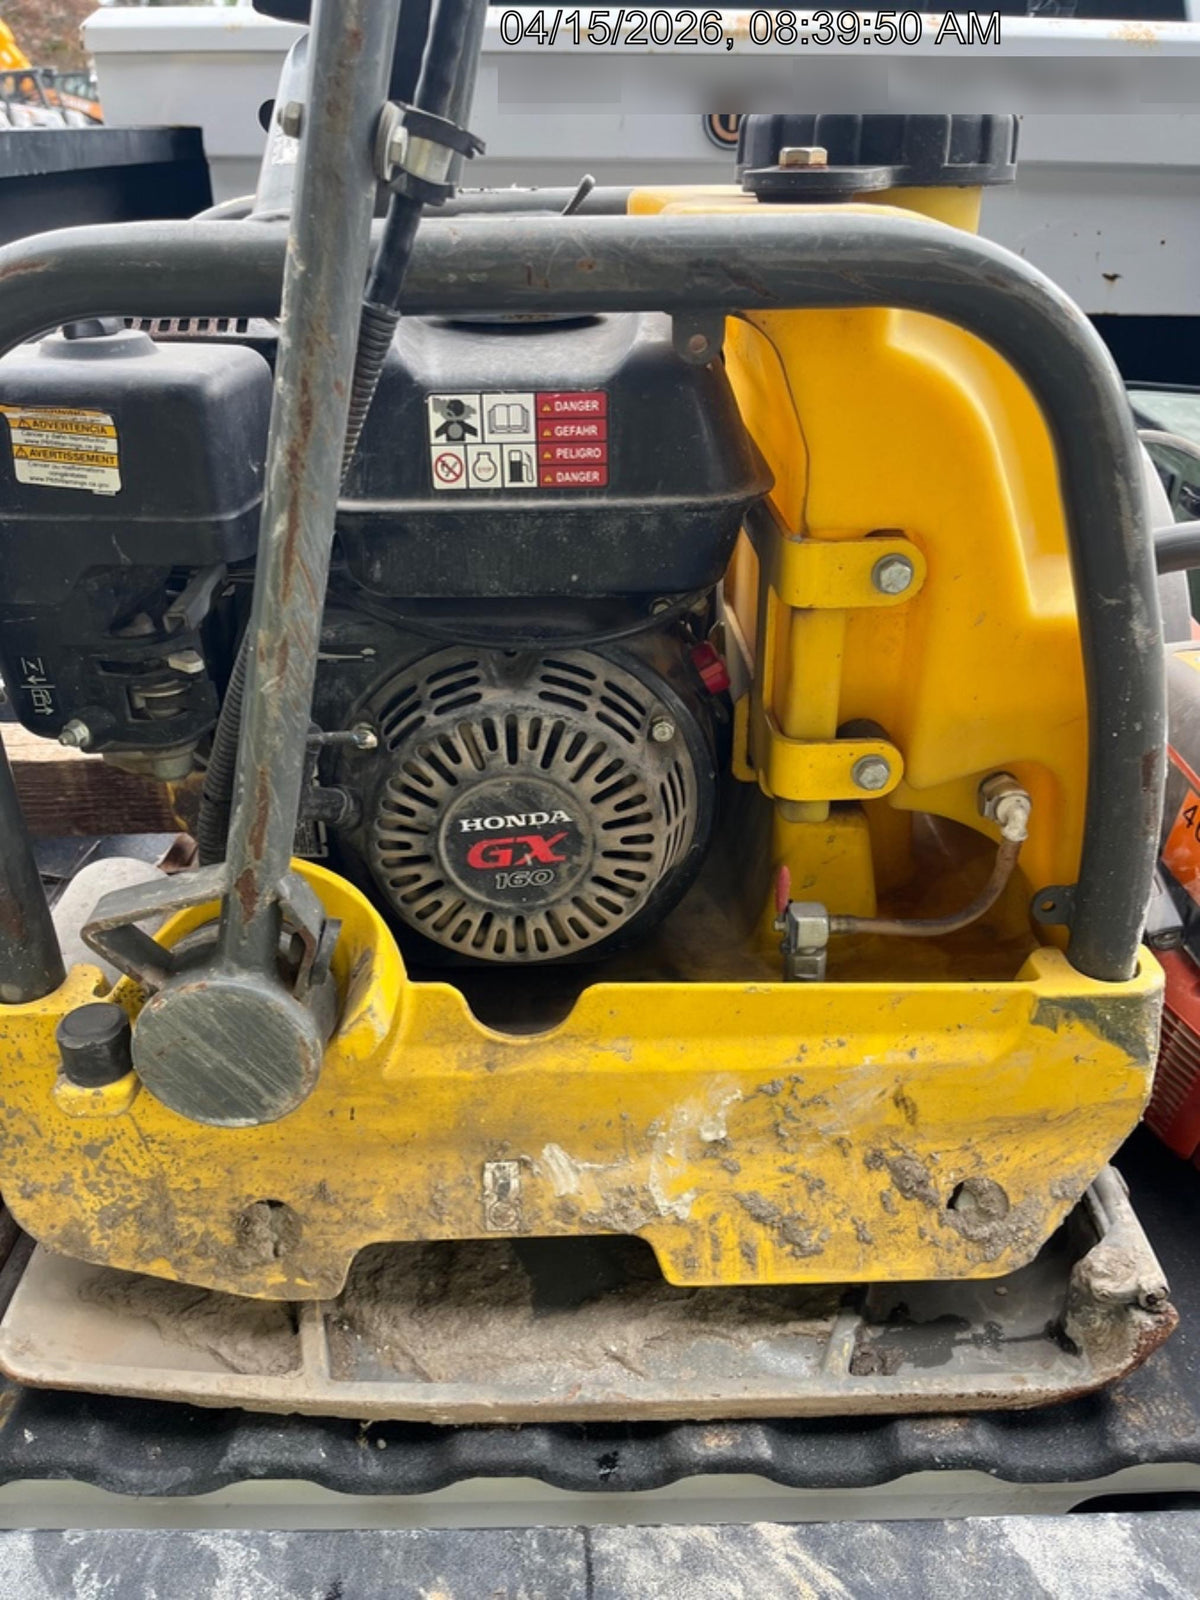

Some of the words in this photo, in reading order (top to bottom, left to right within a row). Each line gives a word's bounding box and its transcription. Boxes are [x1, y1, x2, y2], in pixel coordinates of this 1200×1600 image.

[554, 400, 599, 412] DANGER
[32, 420, 108, 435] ADVERTENCIA
[554, 425, 598, 437] GEFAHR
[29, 448, 115, 465] AVERTISSEMENT
[556, 447, 601, 459] PELIGRO
[556, 471, 600, 483] DANGER
[459, 810, 574, 832] HONDA
[467, 831, 569, 869] GX
[495, 869, 555, 890] 160
